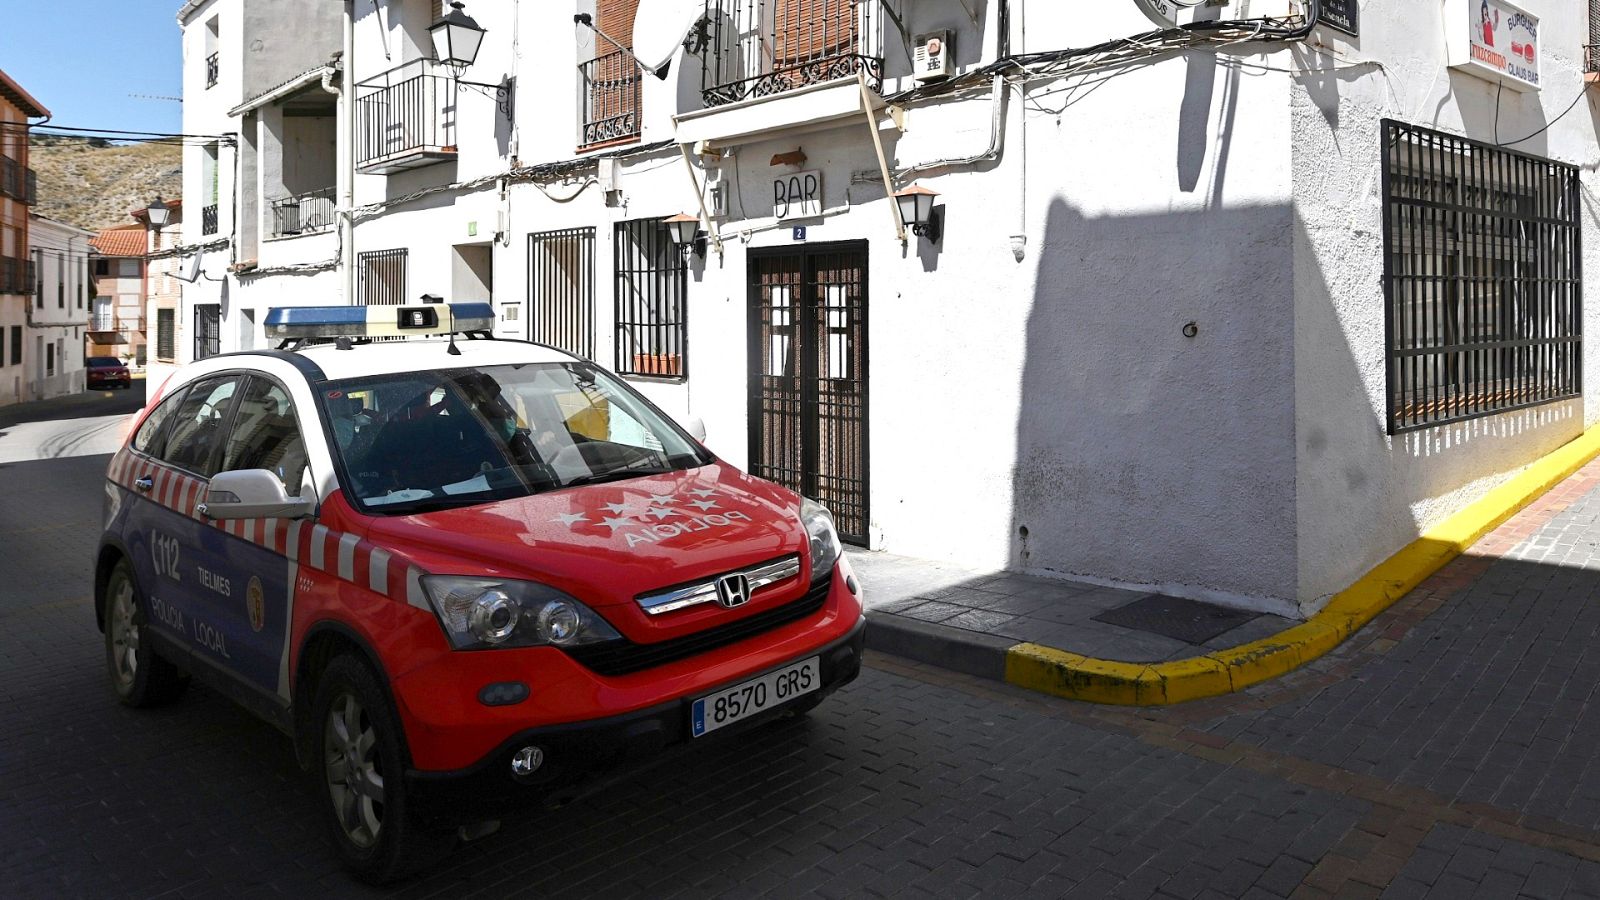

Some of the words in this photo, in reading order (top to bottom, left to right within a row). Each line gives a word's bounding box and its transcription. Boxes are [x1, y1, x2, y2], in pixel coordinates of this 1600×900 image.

[1507, 13, 1537, 41] BURGUER
[1471, 43, 1506, 70] ruzcampo
[1508, 62, 1527, 80] CLAUS
[1527, 68, 1539, 84] BAR
[774, 174, 817, 219] BAR
[796, 228, 802, 239] 2
[158, 534, 181, 581] 112
[197, 566, 231, 598] TIELMES
[150, 595, 186, 634] POLICIA
[193, 619, 231, 659] LOCAL
[714, 681, 767, 723] 8570
[775, 664, 812, 699] GRS
